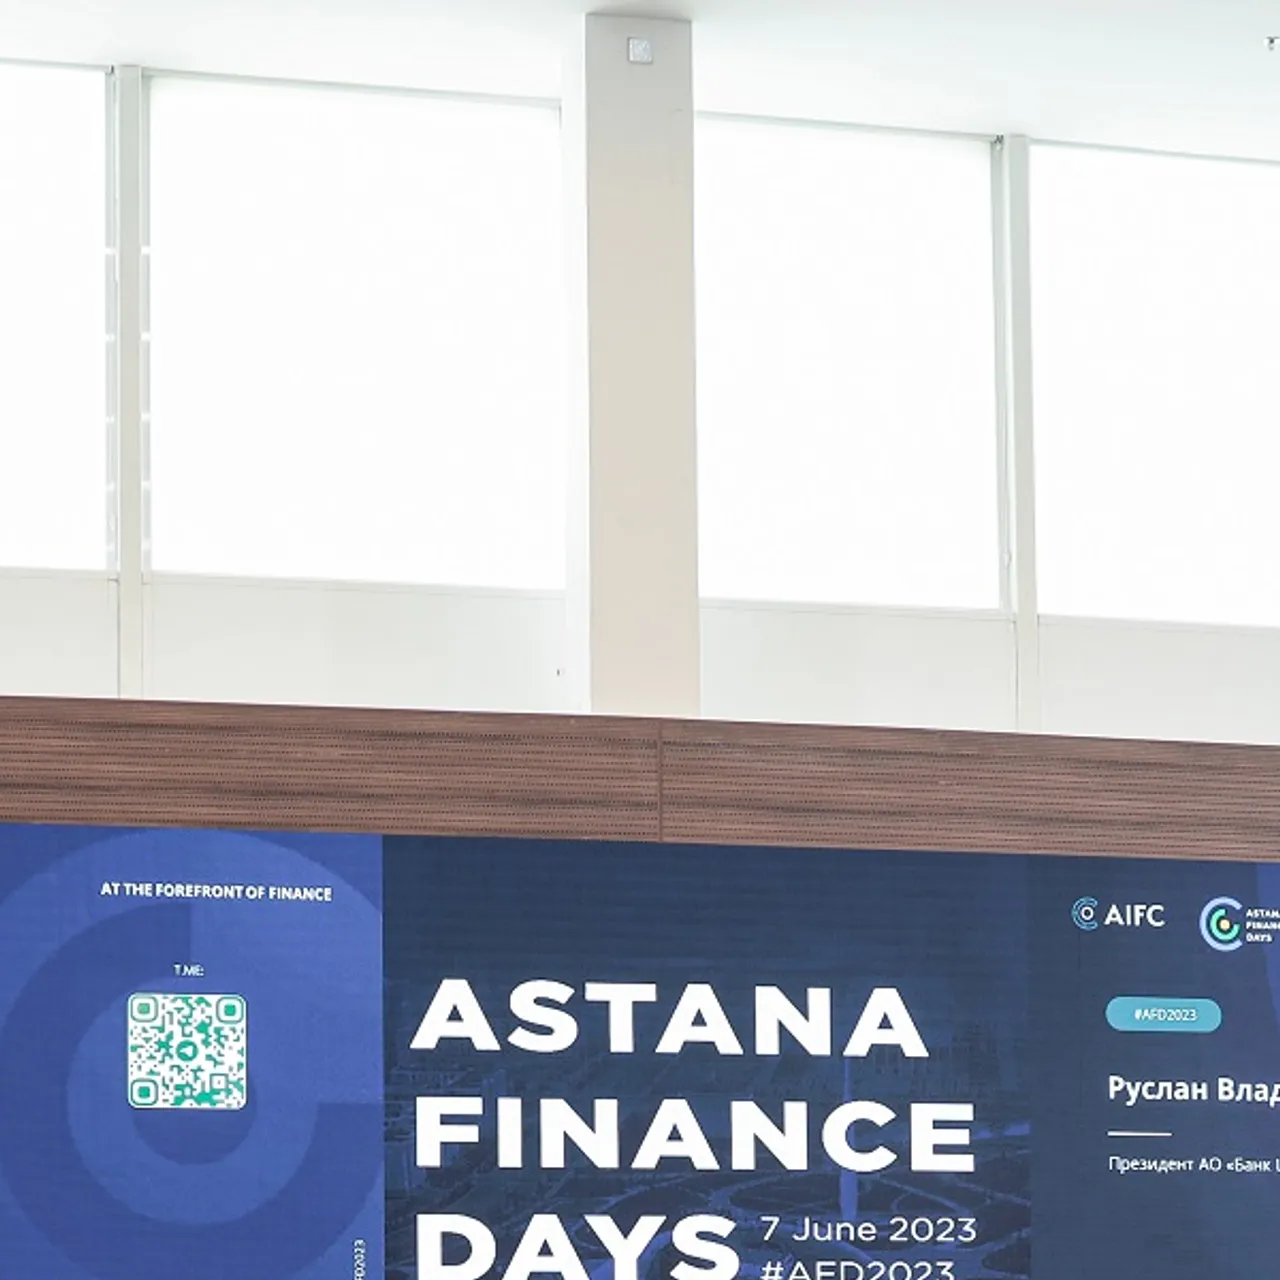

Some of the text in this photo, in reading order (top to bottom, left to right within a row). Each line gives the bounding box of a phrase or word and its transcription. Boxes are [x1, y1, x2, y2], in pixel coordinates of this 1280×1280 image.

[100, 882, 332, 901] AT THE FOREFRONT OF FINANCE
[1104, 904, 1165, 927] AIFC
[410, 977, 930, 1058] ASTANA
[1134, 1008, 1198, 1022] #AFD2023
[1108, 1075, 1208, 1106] Руслан
[415, 1095, 976, 1173] FINANCE
[1108, 1156, 1194, 1174] Президент
[1199, 1157, 1222, 1172] АО
[1226, 1157, 1271, 1173] «Банк
[760, 1216, 978, 1243] 7 June 2023
